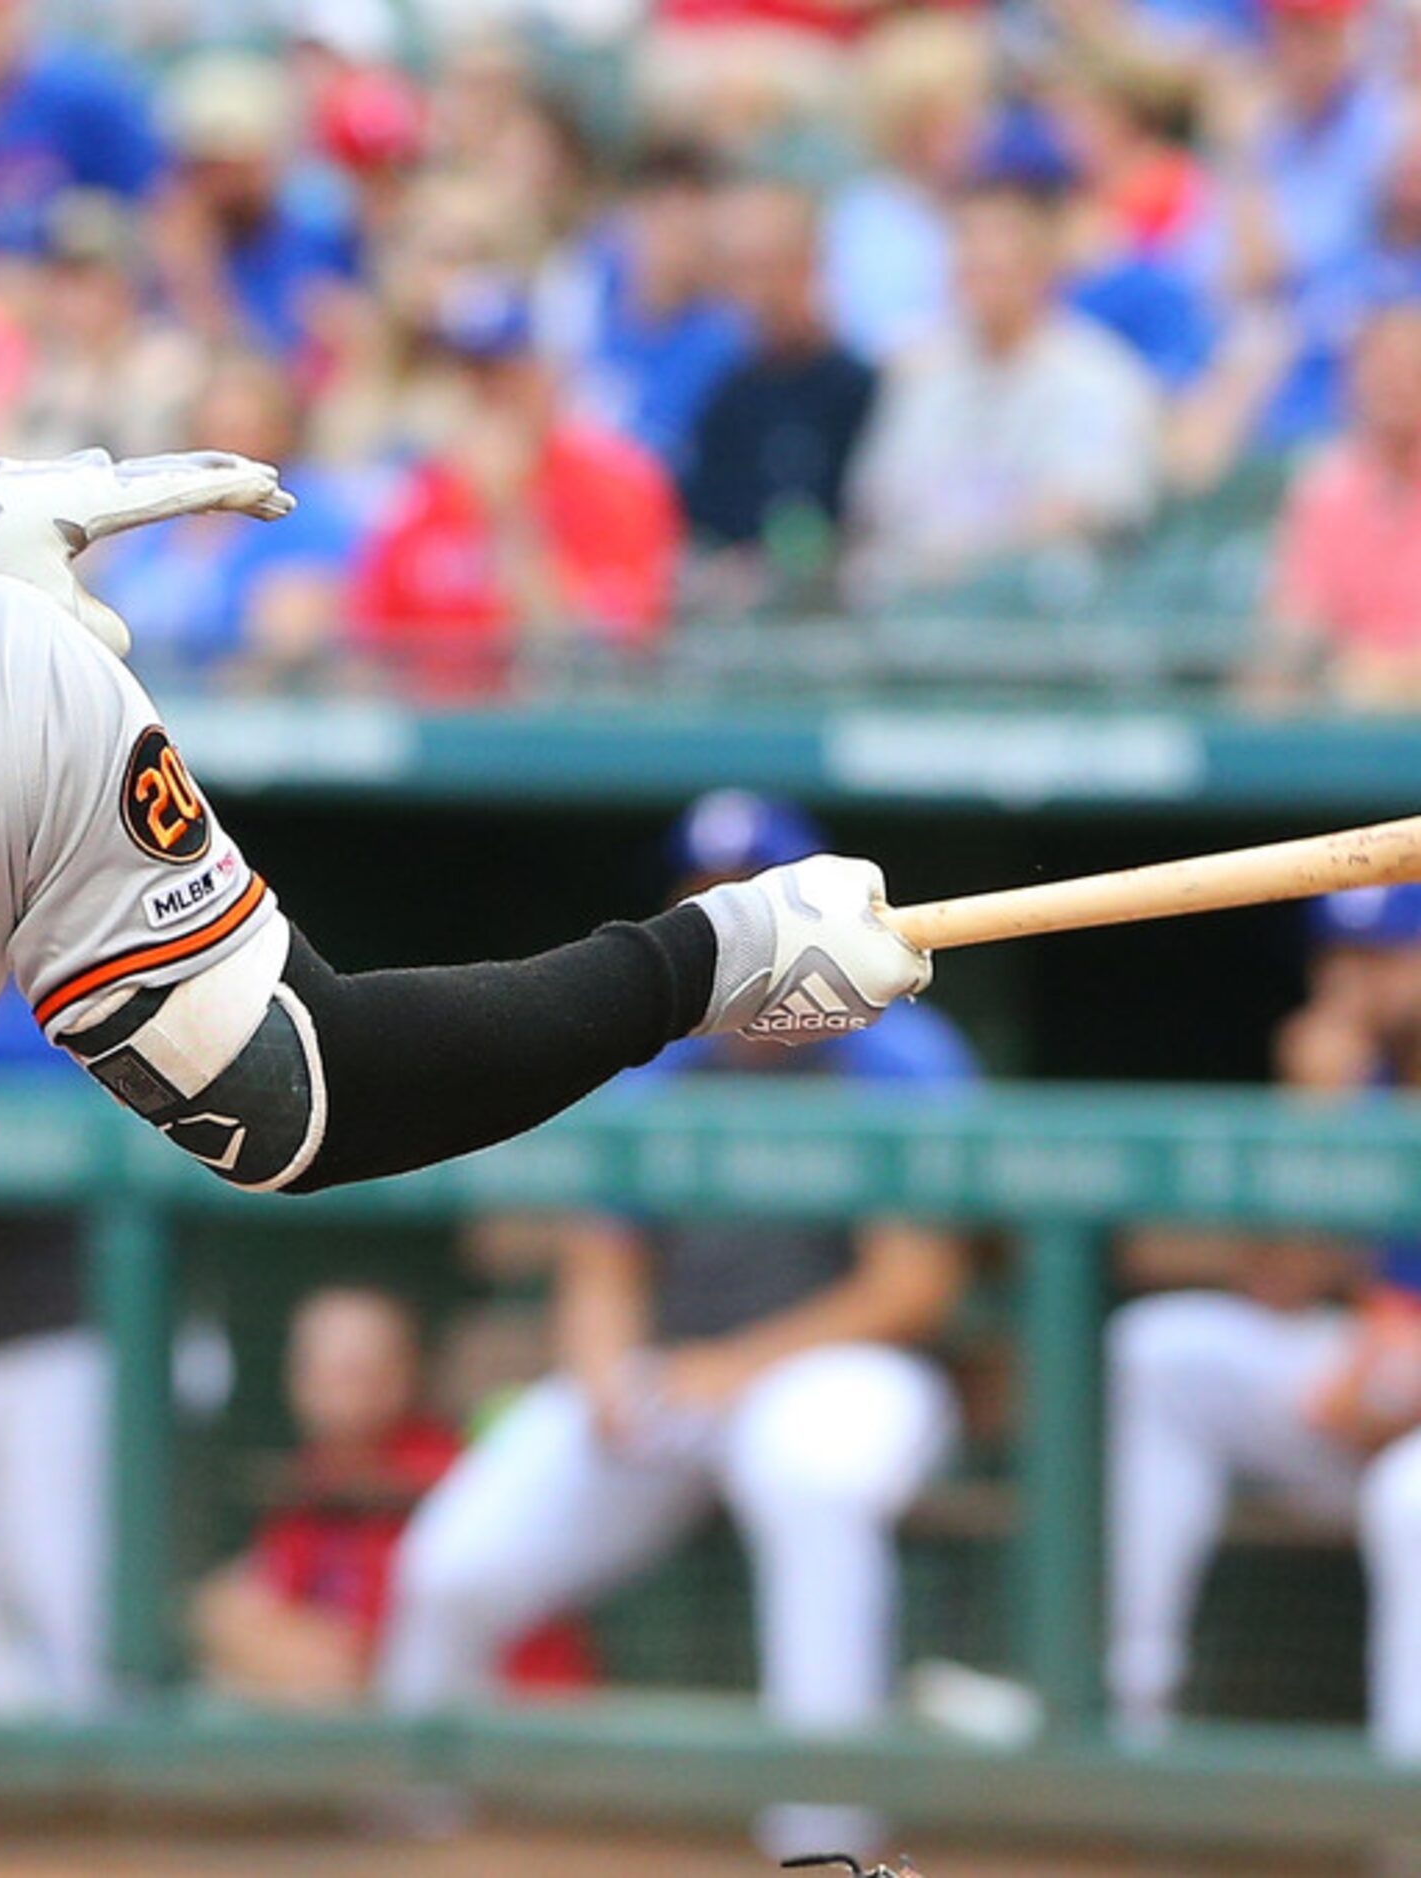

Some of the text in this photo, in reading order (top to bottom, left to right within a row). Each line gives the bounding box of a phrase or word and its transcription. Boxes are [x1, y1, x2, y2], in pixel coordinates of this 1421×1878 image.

[135, 746, 201, 849] 20
[153, 880, 206, 919] MLB
[751, 1011, 867, 1032] adidas
